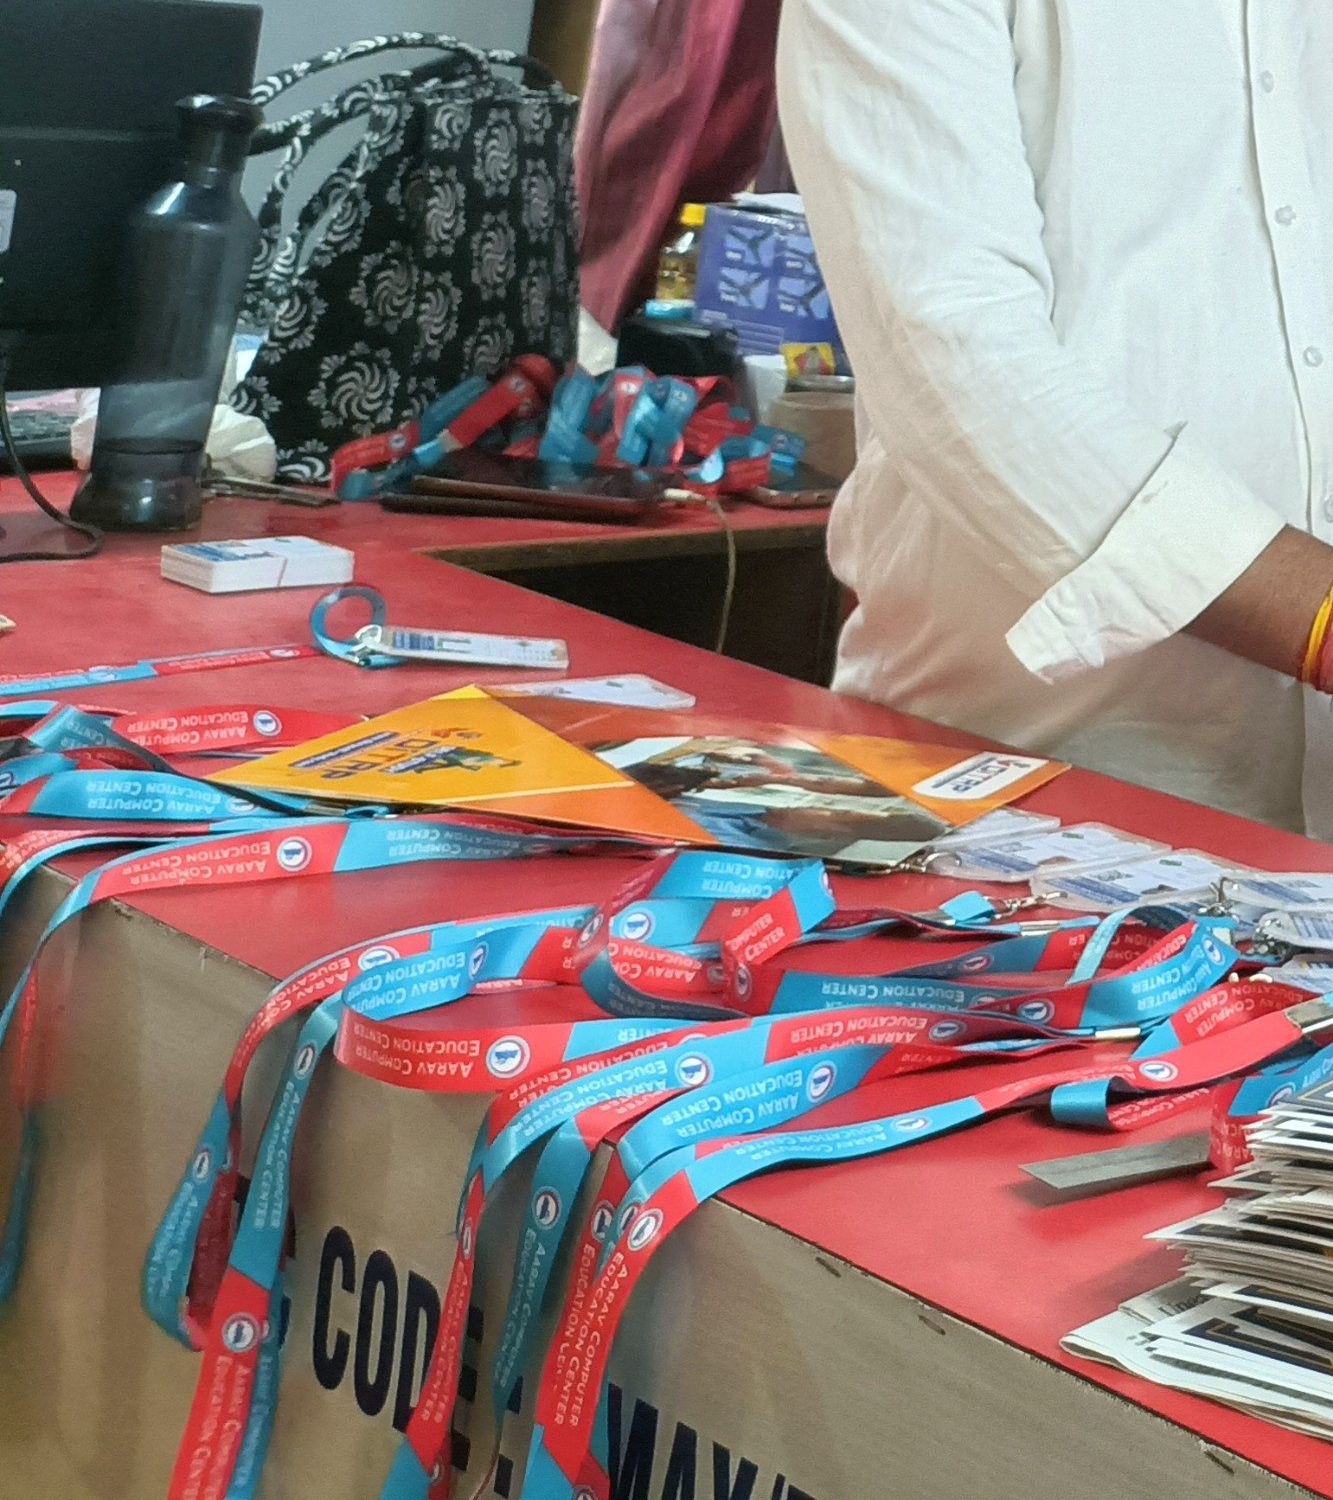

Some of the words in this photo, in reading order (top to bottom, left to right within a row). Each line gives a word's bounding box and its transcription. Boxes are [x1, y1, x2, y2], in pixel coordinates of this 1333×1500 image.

[127, 716, 177, 734] CENTER
[181, 711, 248, 729] EDUCATION
[128, 731, 200, 750] COMPUTER
[203, 724, 247, 742] AARAV
[86, 779, 142, 797] CENTER
[88, 797, 164, 812] COMPUTER
[386, 828, 440, 842] CENTER
[186, 840, 271, 863] EDUCATION
[129, 864, 212, 886] COMPUTER
[217, 860, 266, 875] AARAV
[702, 861, 751, 879] CENTER
[702, 879, 773, 898] COMPUTER
[385, 951, 466, 983] EDUCATION
[646, 965, 696, 982] AARAV
[296, 970, 348, 1000] AARAV
[410, 973, 460, 995] AARAV
[821, 981, 878, 999] CENTER
[1131, 966, 1180, 993] CENTER
[883, 985, 965, 1010] EDUCATION
[790, 1020, 843, 1043] CENTER
[848, 1014, 927, 1030] EDUCATION
[353, 1022, 390, 1049] CENTER
[393, 1037, 480, 1057] EDUCATION
[354, 1044, 412, 1075] COMPUTER
[416, 1061, 473, 1078] AARAV
[576, 1058, 668, 1093] EDUCATION
[723, 1069, 802, 1100] EDUCATION
[615, 1077, 668, 1099] AARAV
[661, 1095, 721, 1126] CENTER
[758, 1091, 798, 1116] AARAV
[676, 1108, 754, 1139] COMPUTER
[564, 1243, 596, 1339] EDUCATION
[575, 1251, 625, 1352] EDUCATION
[597, 1264, 628, 1327] AARAV
[569, 1330, 601, 1427] COMPUTER
[554, 1355, 580, 1426] CENTER
